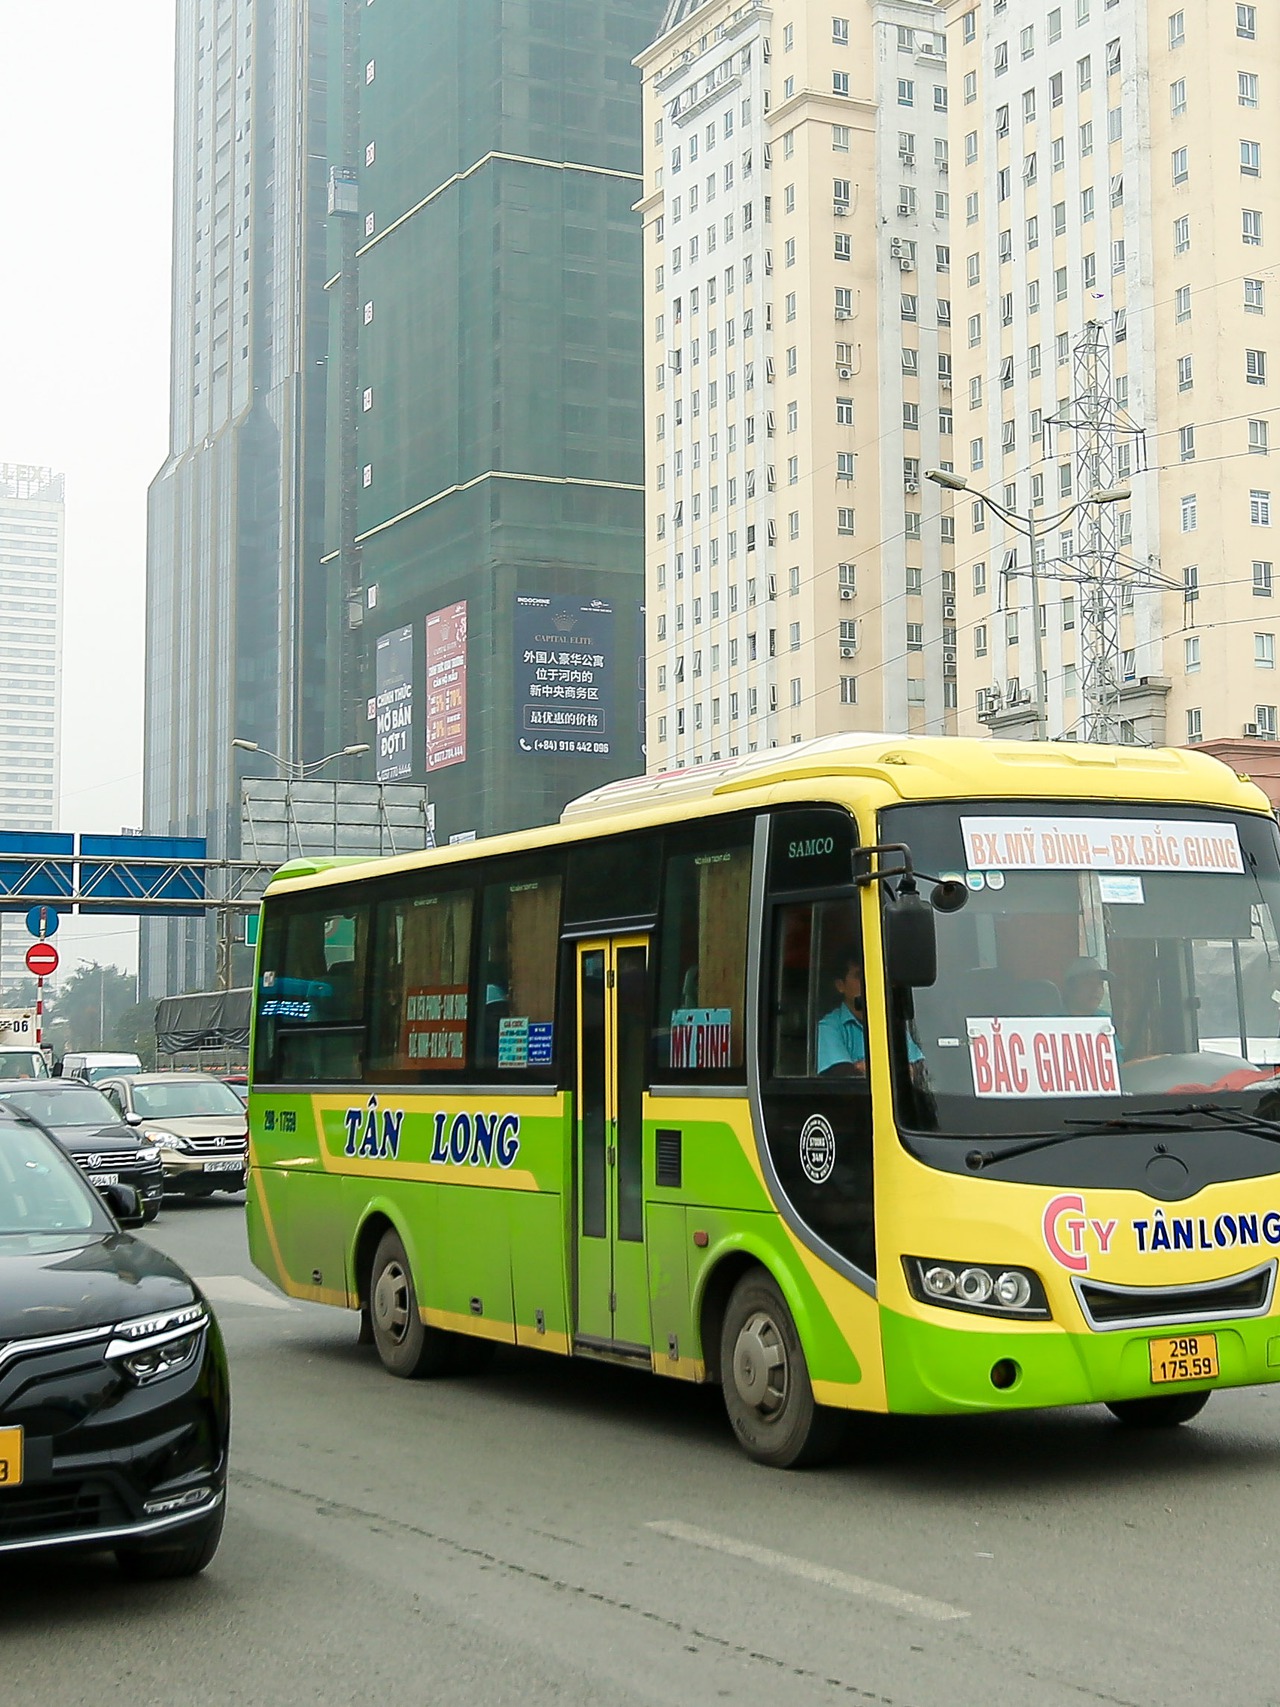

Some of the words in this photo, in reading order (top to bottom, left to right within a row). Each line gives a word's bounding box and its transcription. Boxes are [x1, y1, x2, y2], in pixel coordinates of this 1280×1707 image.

[534, 634, 567, 644] CAPITAL
[570, 636, 594, 646] ELITE
[524, 650, 604, 668] 外国人豪华公寓
[536, 668, 593, 683] 位于河内的
[530, 684, 599, 700] 新中央商务区
[377, 706, 392, 735] MỞ
[392, 704, 412, 728] BÁN
[530, 711, 598, 726] 最优惠的价格
[381, 732, 400, 760] ĐỢT
[534, 739, 558, 751] (+84)
[560, 740, 575, 752] 916
[576, 741, 592, 752] 442
[788, 837, 834, 858] SAMCO
[970, 826, 1036, 866] BX.MỸ
[1183, 836, 1239, 868] GIANG
[670, 1015, 692, 1068] MỸ
[696, 1012, 731, 1068] ĐÌNH
[974, 1017, 1029, 1093] BẮC
[1033, 1032, 1116, 1092] GIANG
[344, 1093, 404, 1160] TÂN
[430, 1111, 520, 1169] LONG
[1043, 1194, 1118, 1272] CTY
[1170, 1338, 1198, 1357] 29B
[1161, 1358, 1212, 1379] 175.59
